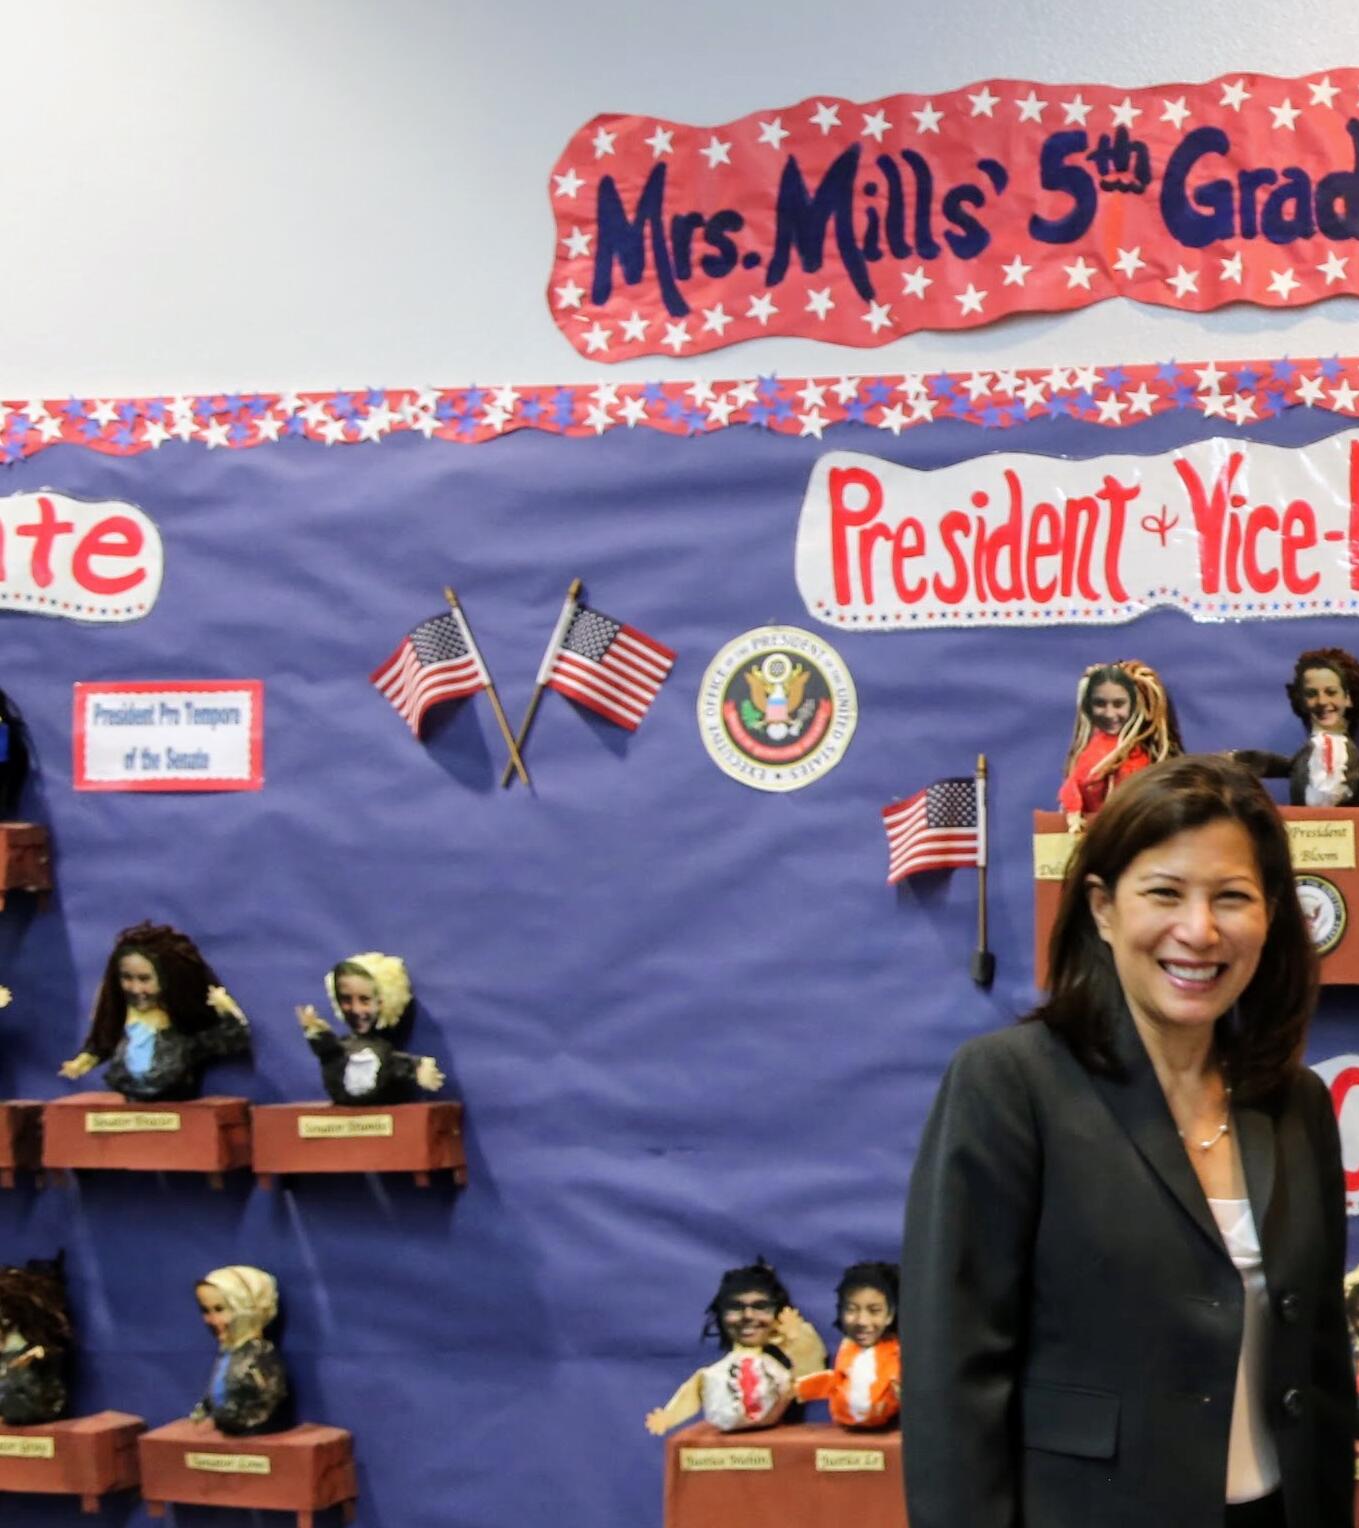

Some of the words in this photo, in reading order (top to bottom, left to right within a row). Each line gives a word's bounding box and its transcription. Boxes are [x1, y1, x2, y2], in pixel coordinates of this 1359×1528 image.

[592, 162, 760, 316] Mrs.
[767, 143, 1008, 302] Mills'
[1029, 127, 1152, 243] 5th
[827, 467, 1141, 606] President
[93, 702, 155, 727] President
[160, 702, 181, 726] Pro
[185, 702, 241, 731] Tempore
[124, 747, 137, 771] of
[141, 747, 161, 771] the
[166, 747, 210, 771] Senate
[1291, 822, 1348, 840] President
[1301, 845, 1339, 862] Bloom
